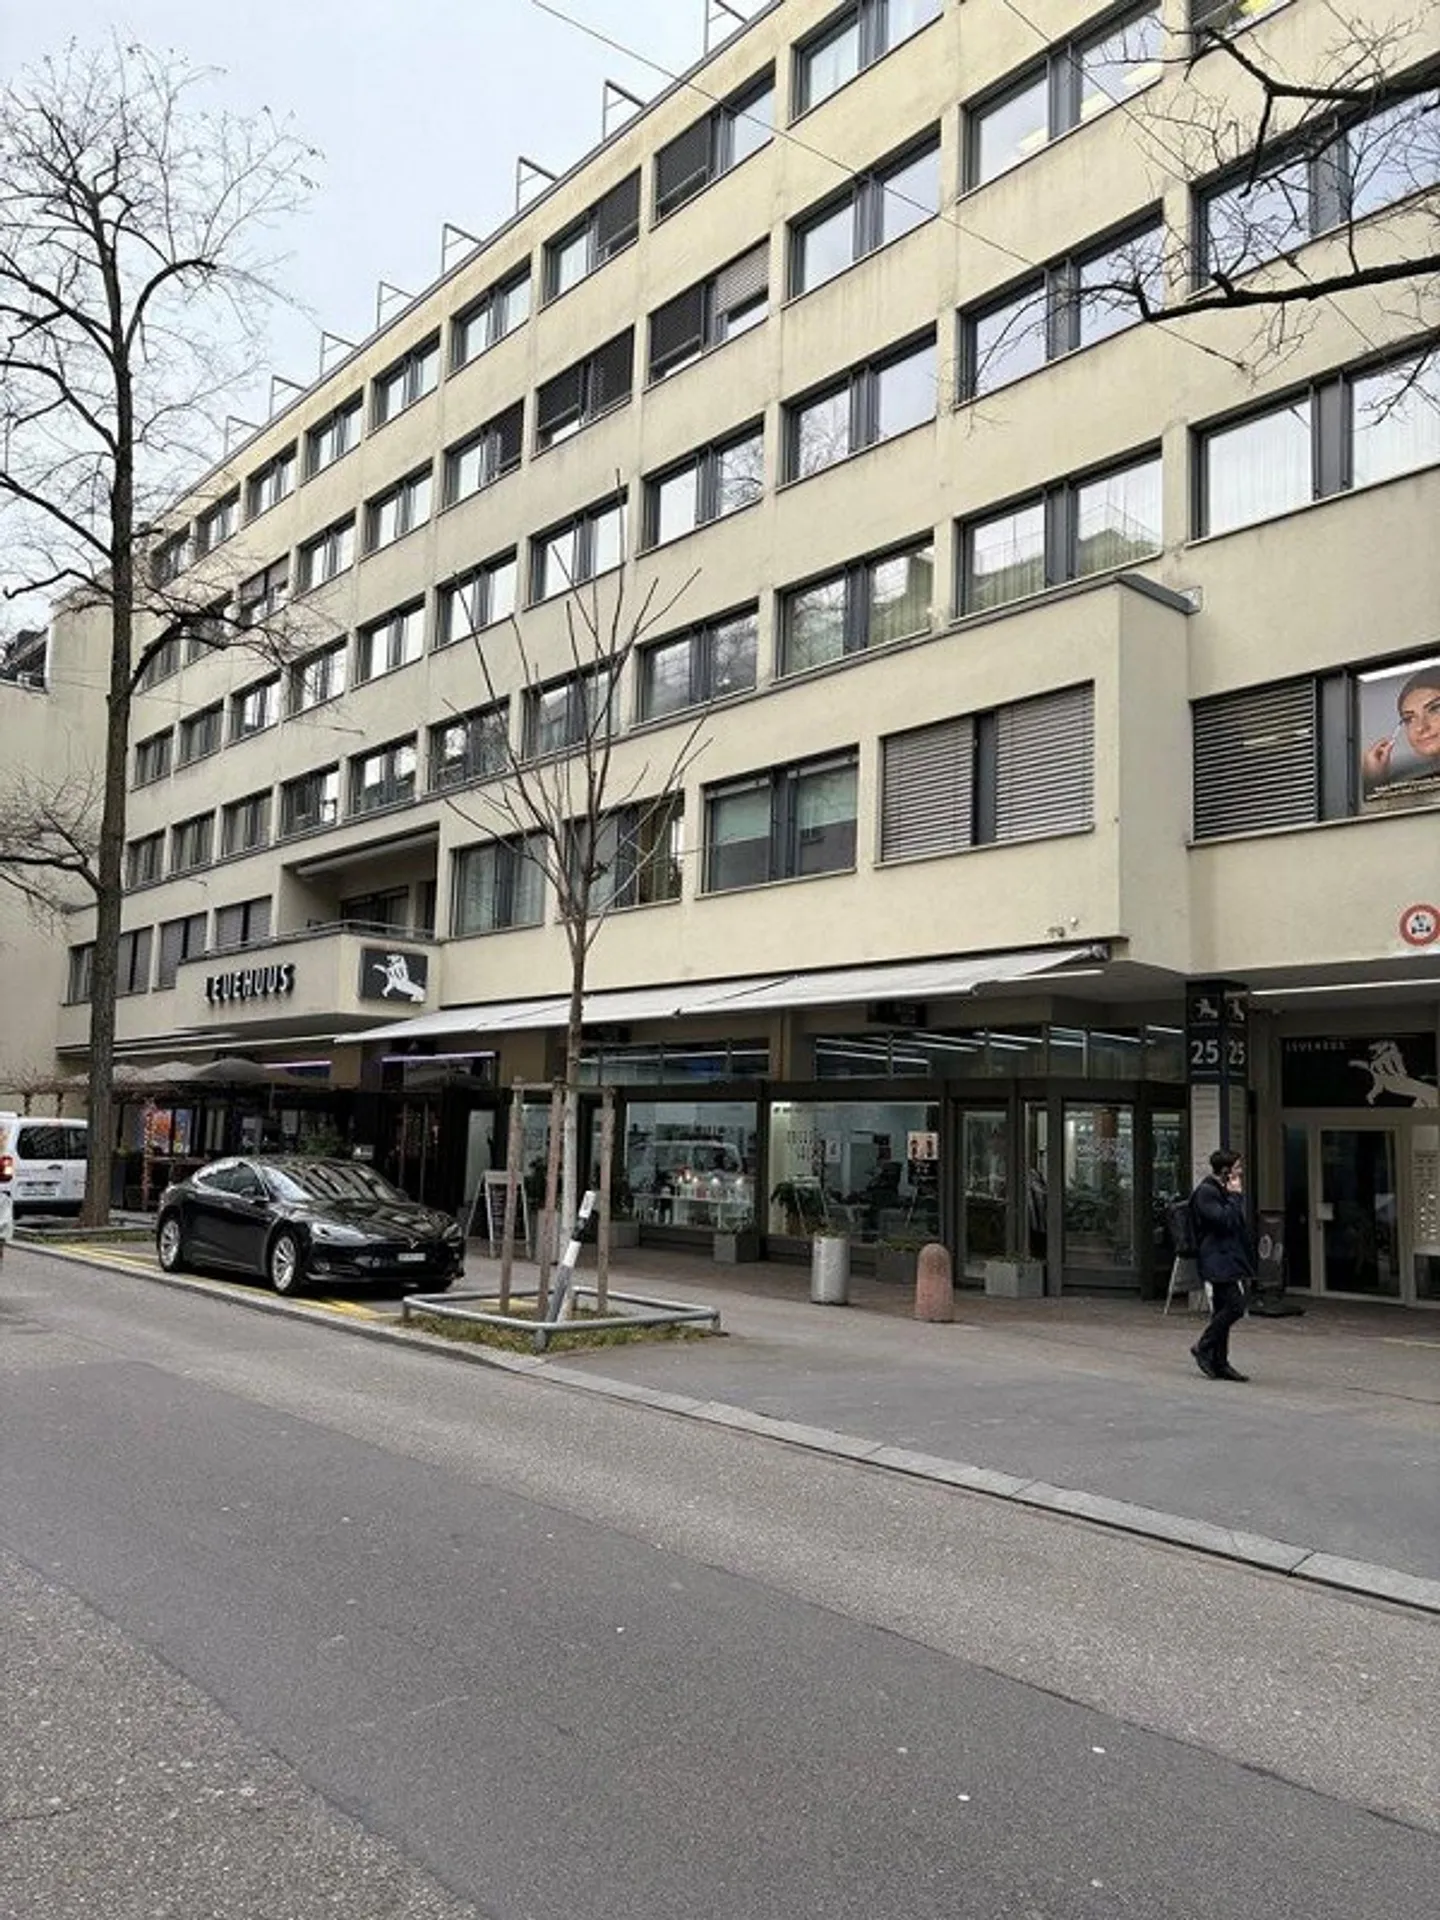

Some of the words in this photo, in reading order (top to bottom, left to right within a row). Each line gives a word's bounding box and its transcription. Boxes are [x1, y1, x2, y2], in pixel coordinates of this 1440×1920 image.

[204, 962, 294, 1003] LEUEHUUS
[1190, 1039, 1219, 1064] 25
[1228, 1039, 1245, 1064] 25
